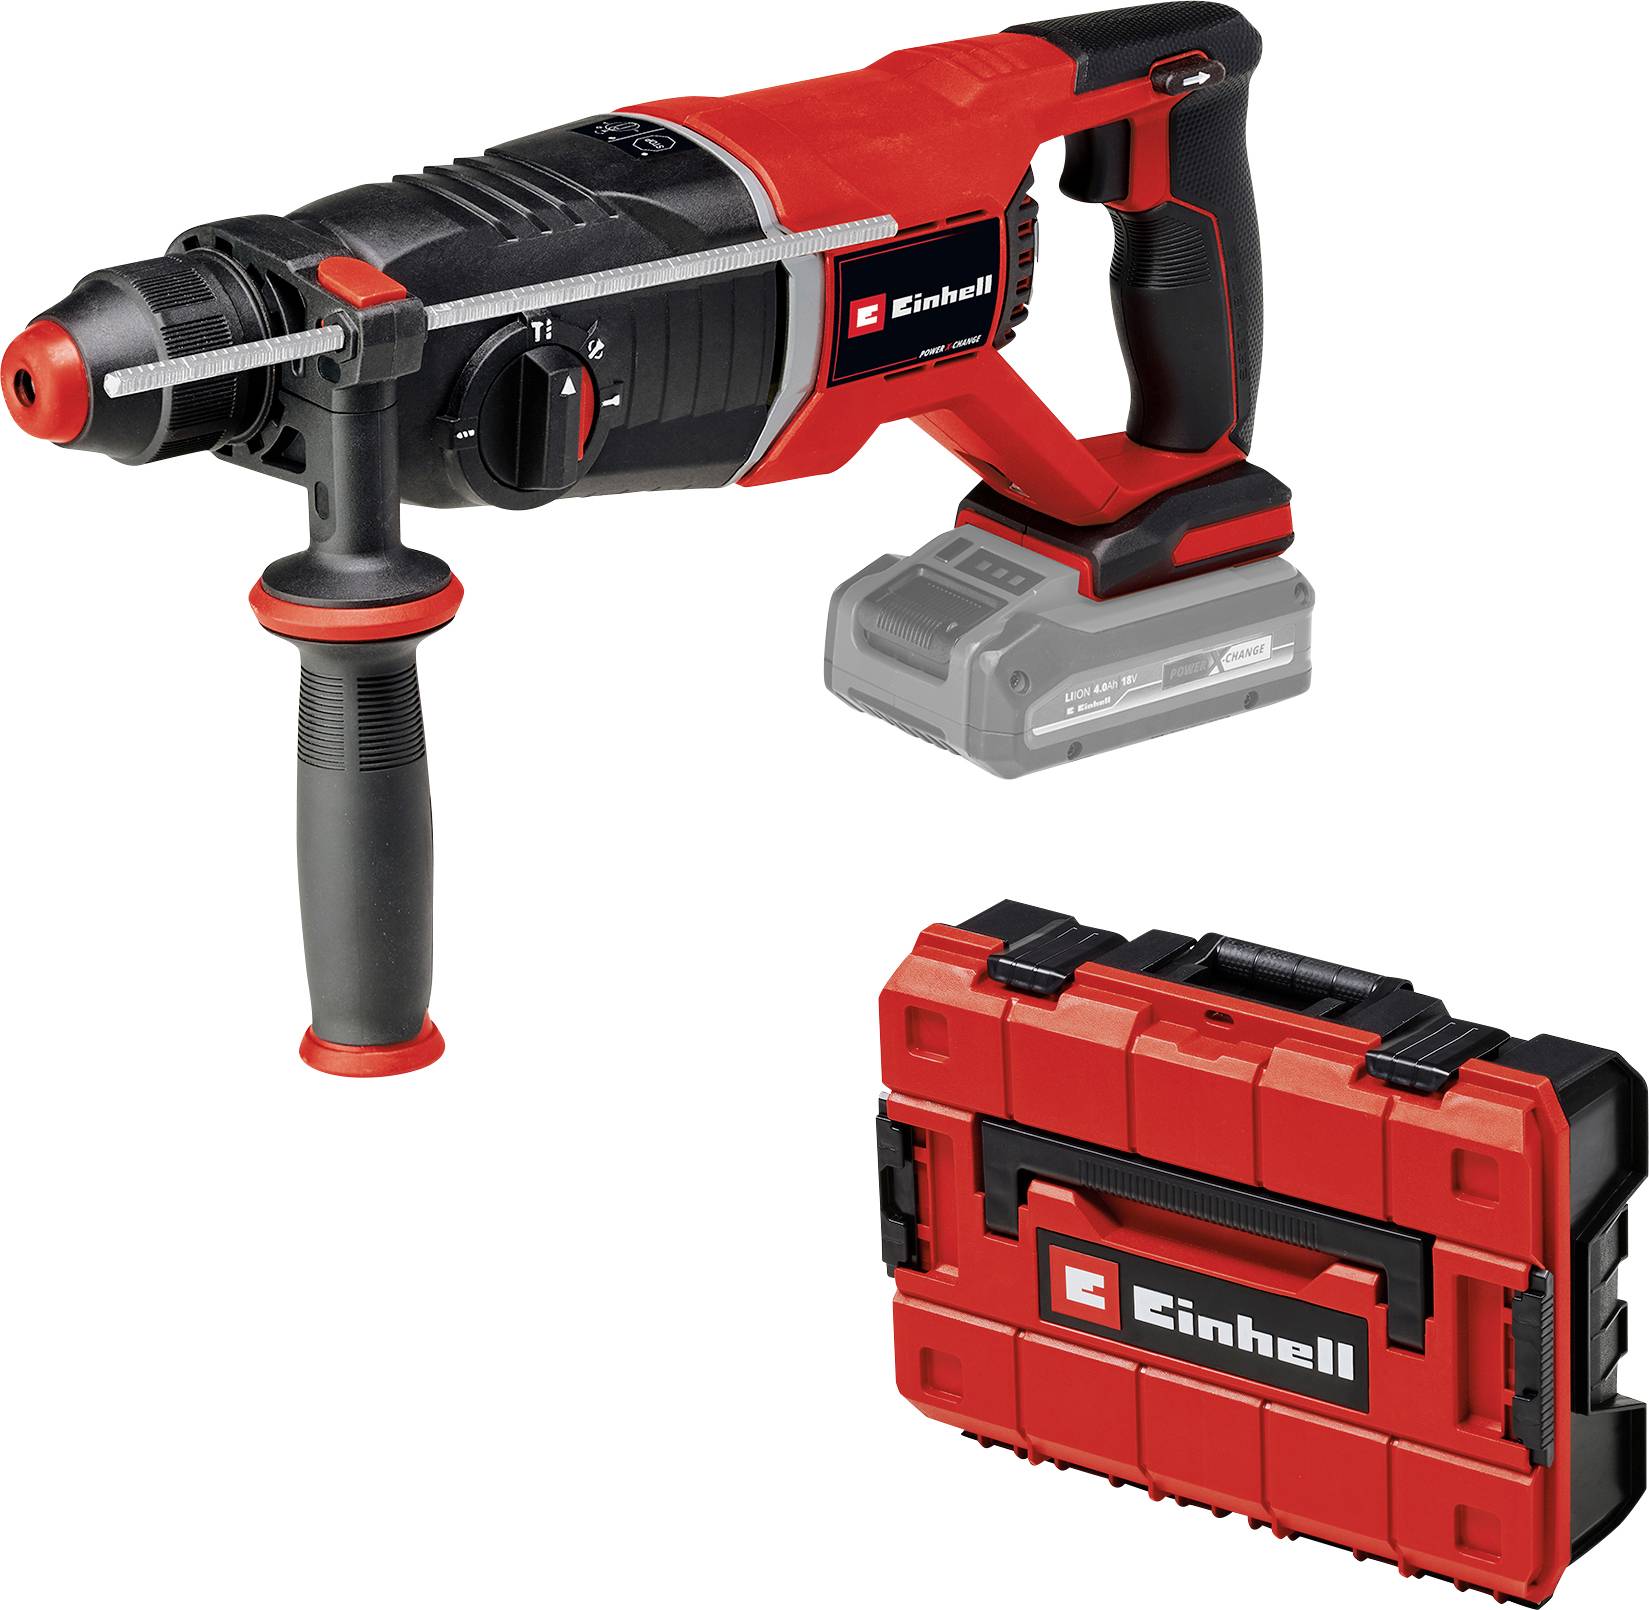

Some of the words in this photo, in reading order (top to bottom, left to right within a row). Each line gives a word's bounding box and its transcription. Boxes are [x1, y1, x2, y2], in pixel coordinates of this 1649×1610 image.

[644, 138, 664, 149] STOP
[891, 274, 993, 319] Einhell
[918, 344, 945, 359] POWER
[1169, 659, 1207, 680] POWER
[1093, 680, 1118, 695] 4.0Ah
[1120, 673, 1138, 687] 18V
[1077, 696, 1111, 713] Einhell
[1132, 1284, 1355, 1382] Einhell
